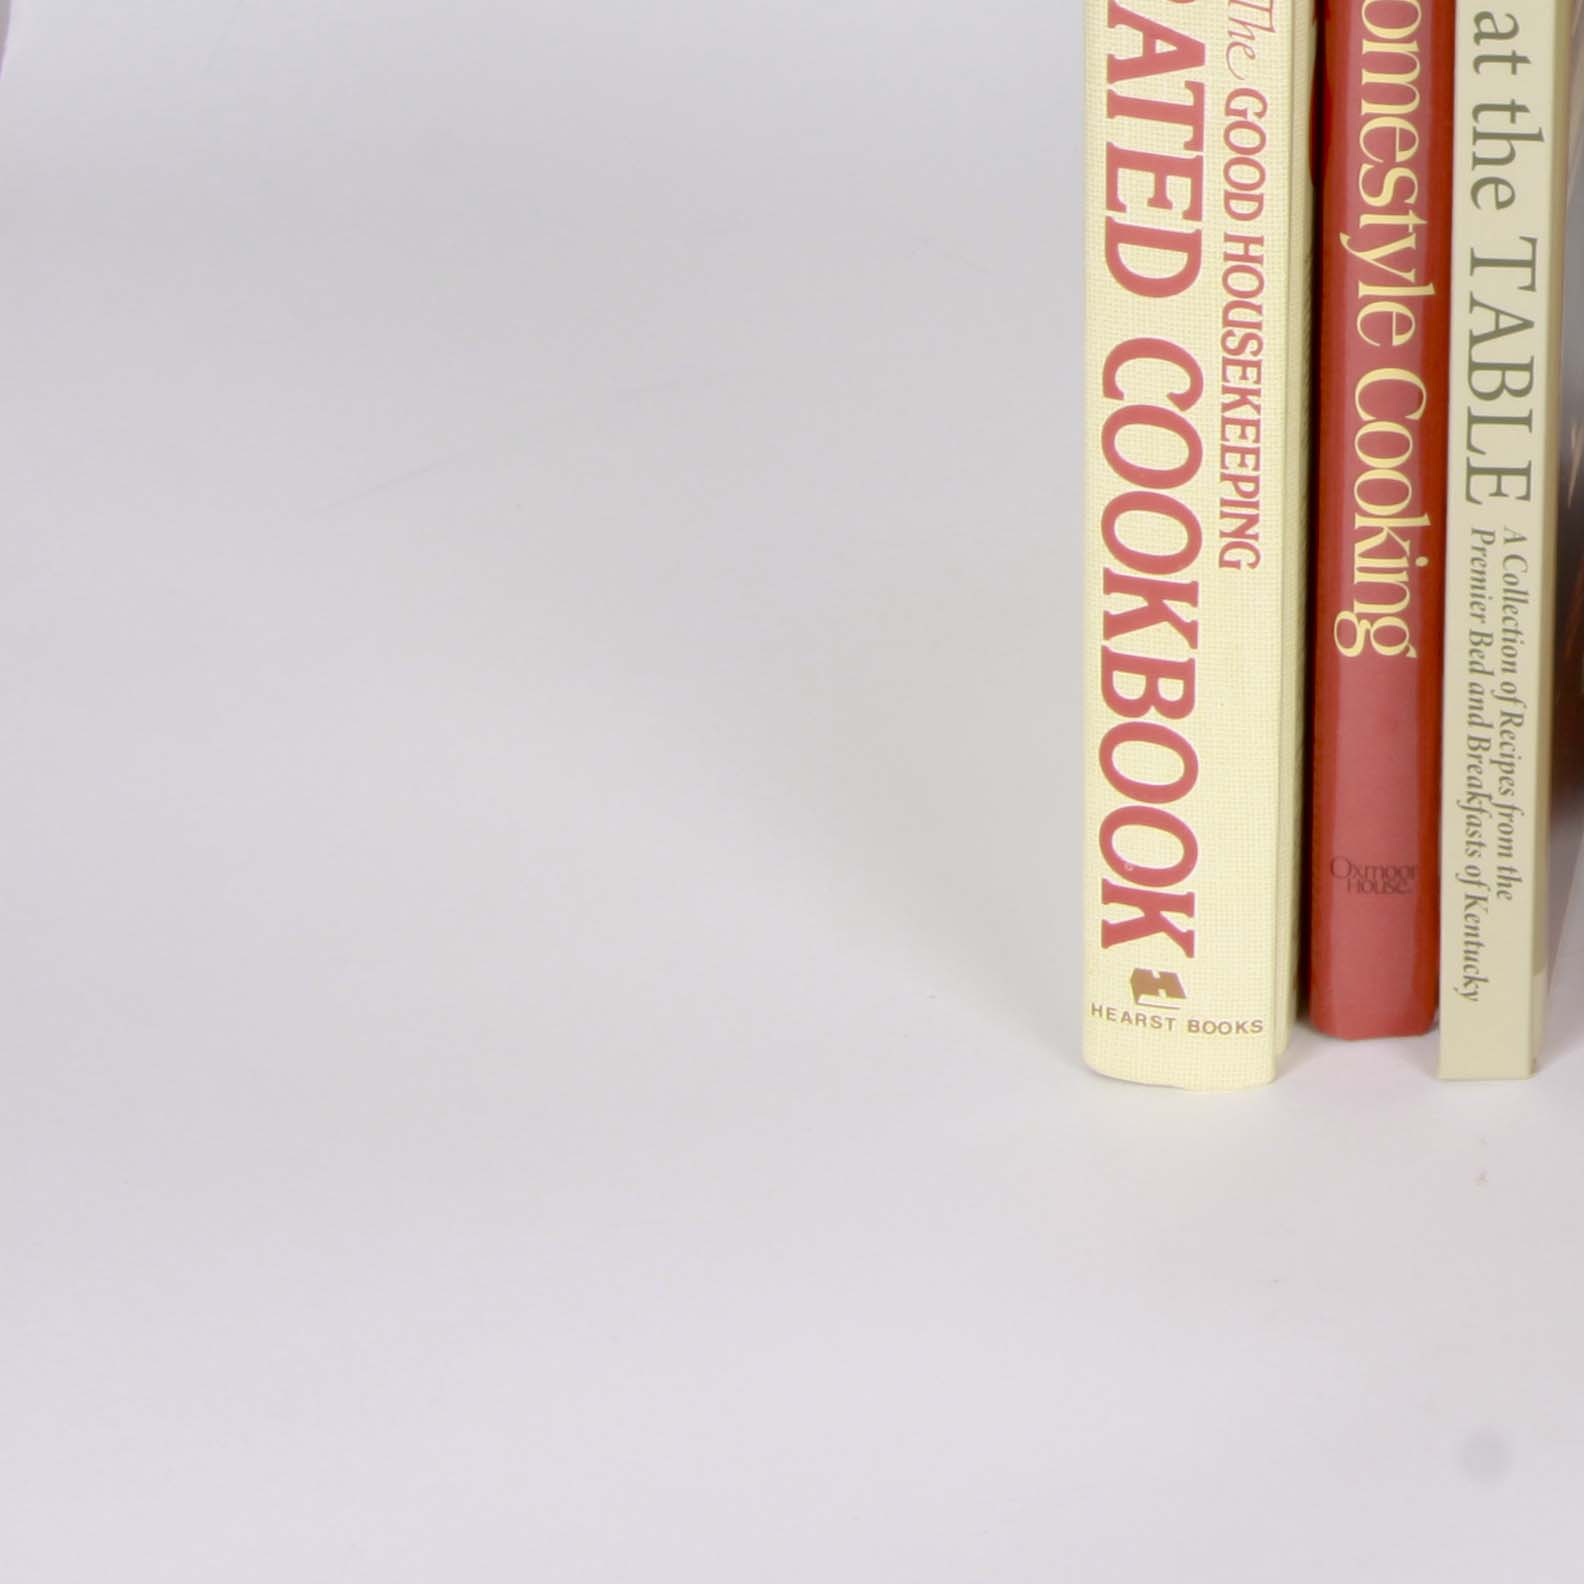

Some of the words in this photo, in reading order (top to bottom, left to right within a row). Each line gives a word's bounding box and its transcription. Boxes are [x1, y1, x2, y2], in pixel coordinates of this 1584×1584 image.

[1472, 12, 1523, 76] at
[1222, 87, 1270, 225] GOOD
[1470, 95, 1545, 212] the
[1218, 239, 1265, 569] HOUSEKEEPING
[1465, 235, 1537, 506] TABLE
[1334, 365, 1431, 660] Cooking
[1503, 525, 1527, 544] A
[1470, 527, 1496, 624] Premier
[1501, 553, 1530, 674] Collection
[1098, 337, 1203, 958] COOKBOOK
[1468, 629, 1495, 676] Bed
[1467, 681, 1494, 729] and
[1490, 680, 1527, 709] of
[1457, 734, 1492, 858] Breakfasts
[1489, 710, 1524, 797] Recipes
[1330, 856, 1417, 880] Oxmoor
[1491, 801, 1525, 859] from
[1456, 865, 1491, 891] of
[1496, 866, 1523, 901] the
[1453, 893, 1489, 1002] Kentucky
[1091, 1002, 1176, 1032] HEARST
[1187, 1019, 1264, 1036] BOOKS
